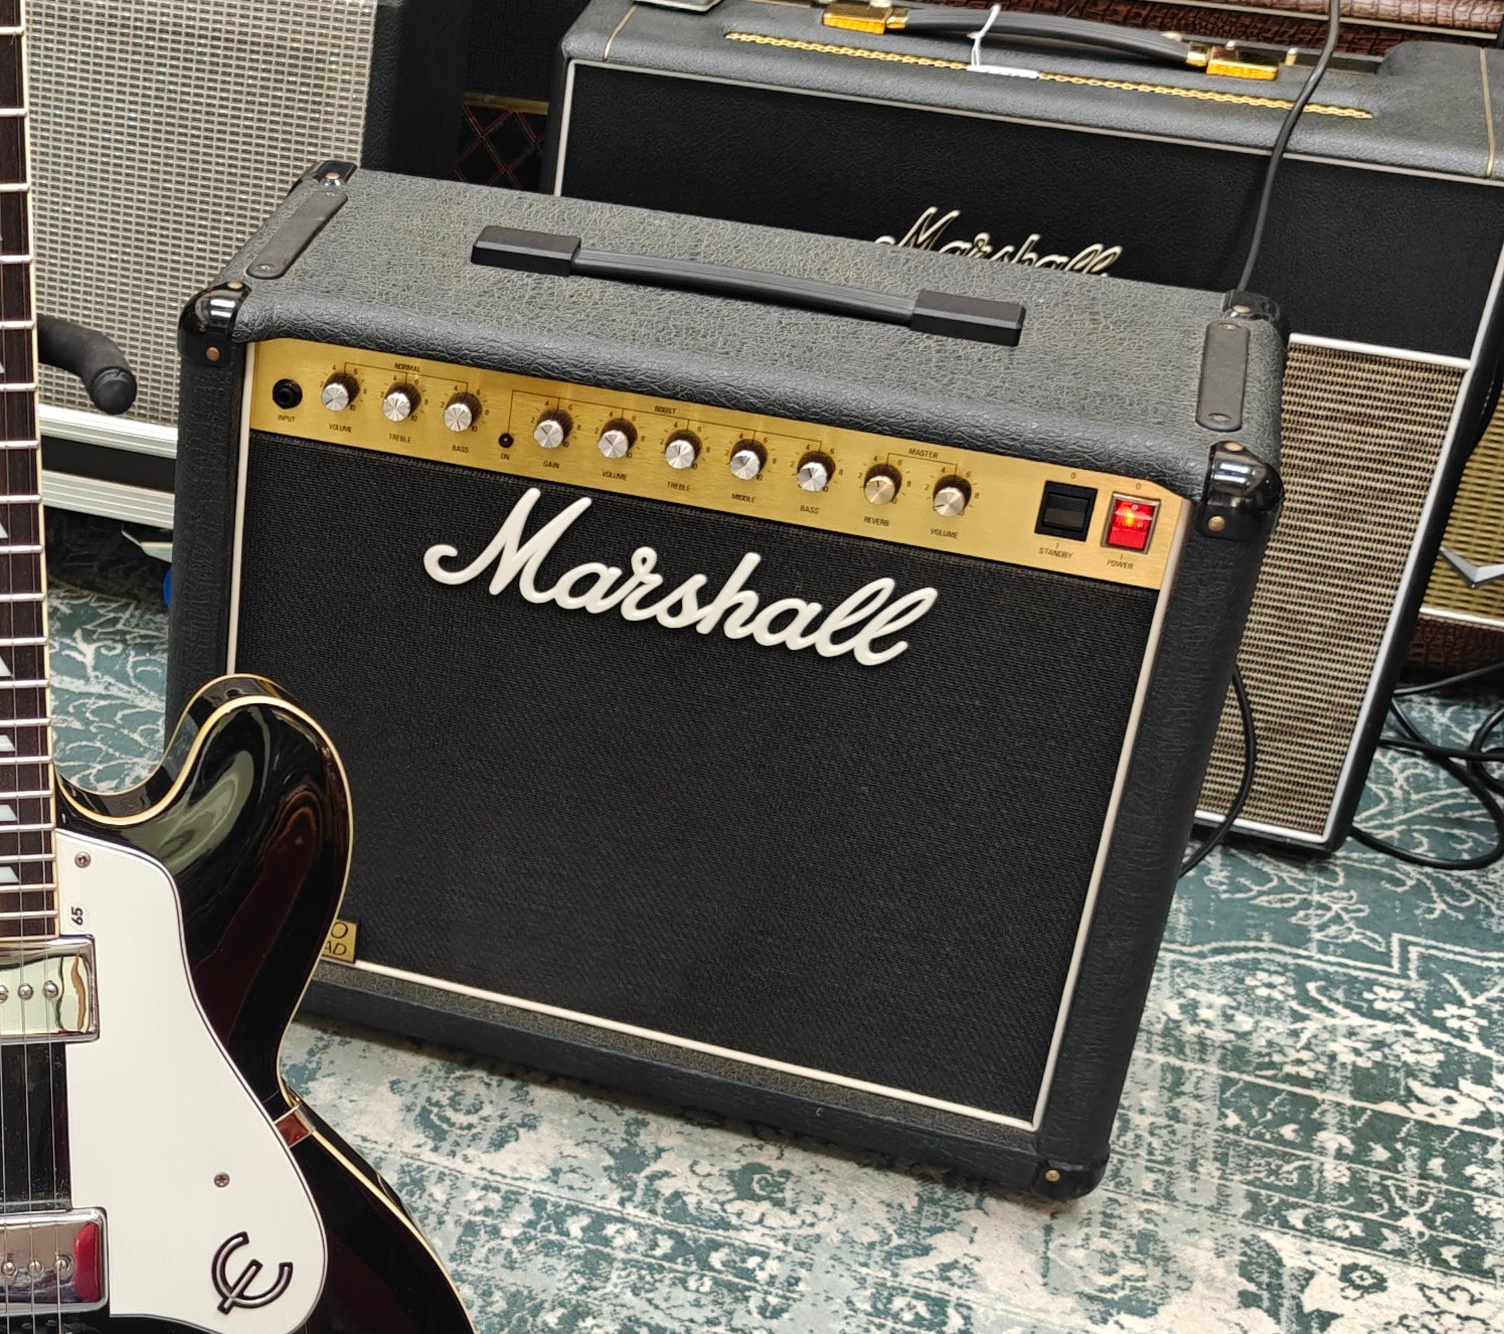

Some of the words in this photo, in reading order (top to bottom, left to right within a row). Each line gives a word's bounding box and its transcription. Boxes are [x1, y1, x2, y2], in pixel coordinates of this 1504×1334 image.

[394, 362, 421, 372] NORMAL
[654, 405, 676, 415] BOOST
[277, 414, 295, 422] INPUT
[328, 423, 352, 433] VOLUME
[388, 432, 411, 444] TREBLE
[452, 444, 469, 454] BASS
[908, 448, 939, 459] MASTER
[500, 453, 510, 461] ON
[543, 460, 560, 469] GAIN
[602, 471, 628, 481] VOLUME
[667, 481, 691, 492] TREBLE
[731, 493, 756, 504] MIDDLE
[799, 505, 820, 515] BASS
[863, 516, 890, 527] REVERB
[930, 528, 959, 539] VOLUME
[1038, 547, 1073, 559] STANDBY
[1106, 559, 1134, 570] POWER
[423, 487, 938, 666] Marshall
[71, 906, 84, 926] 65
